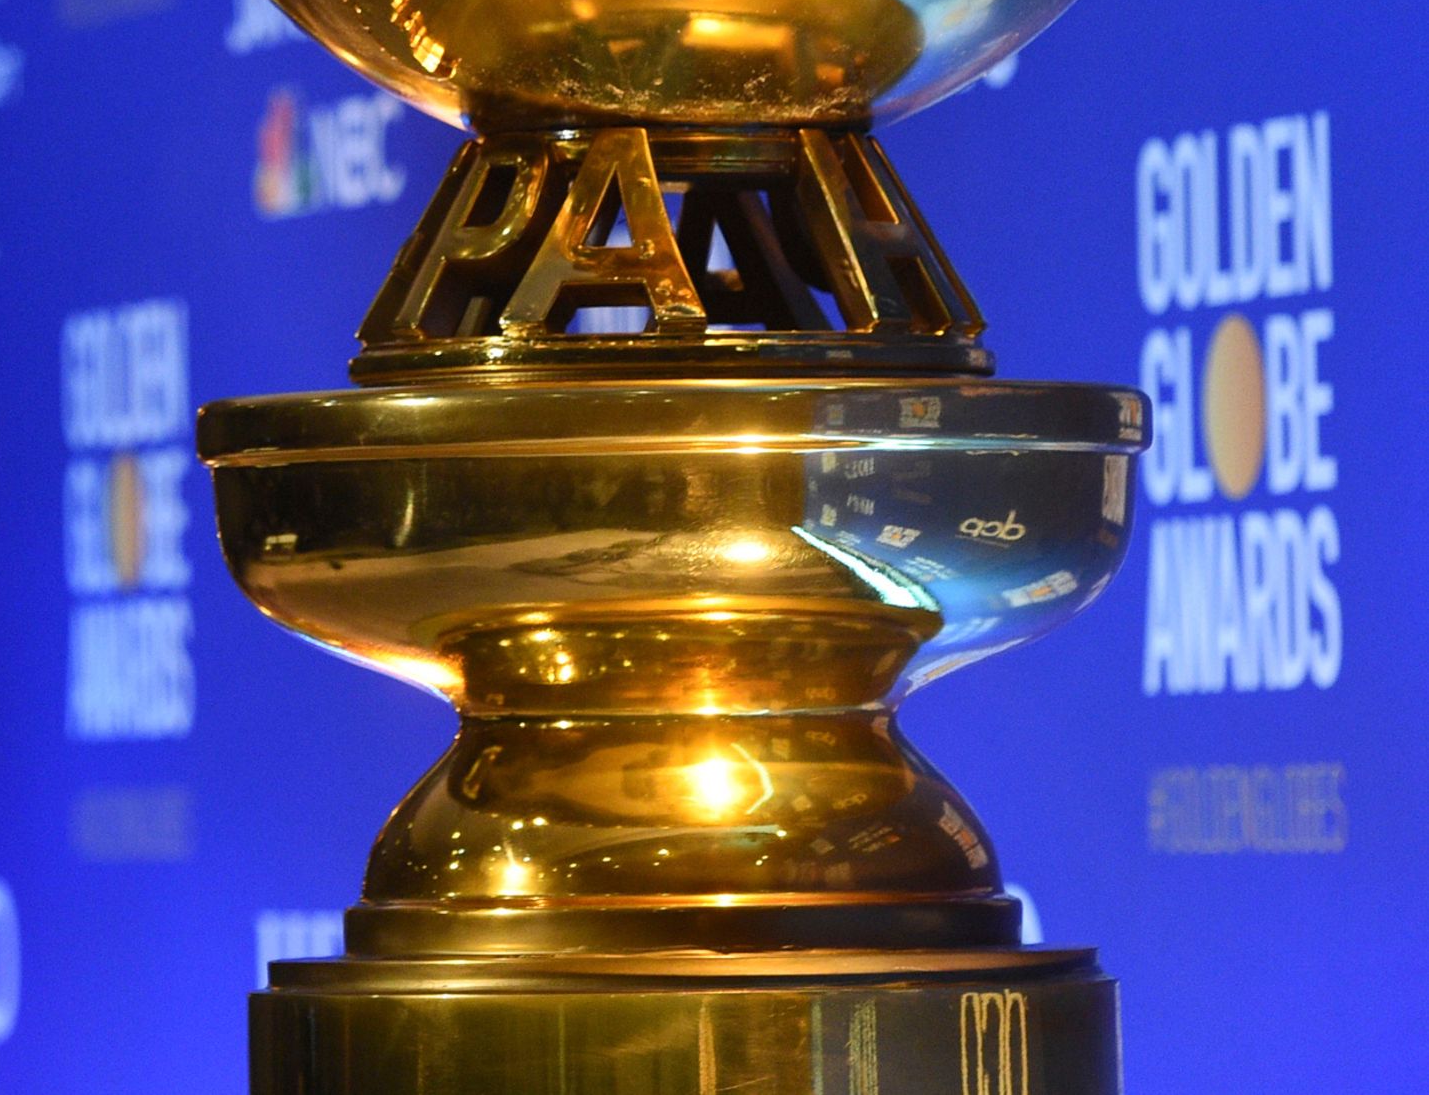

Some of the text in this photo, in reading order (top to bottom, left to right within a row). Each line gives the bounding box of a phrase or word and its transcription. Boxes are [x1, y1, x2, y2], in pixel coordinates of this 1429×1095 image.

[309, 93, 407, 210] NBC
[1136, 112, 1334, 314] GOLDEN
[1138, 310, 1338, 506] GLOBE
[1143, 506, 1342, 697] AWARDS
